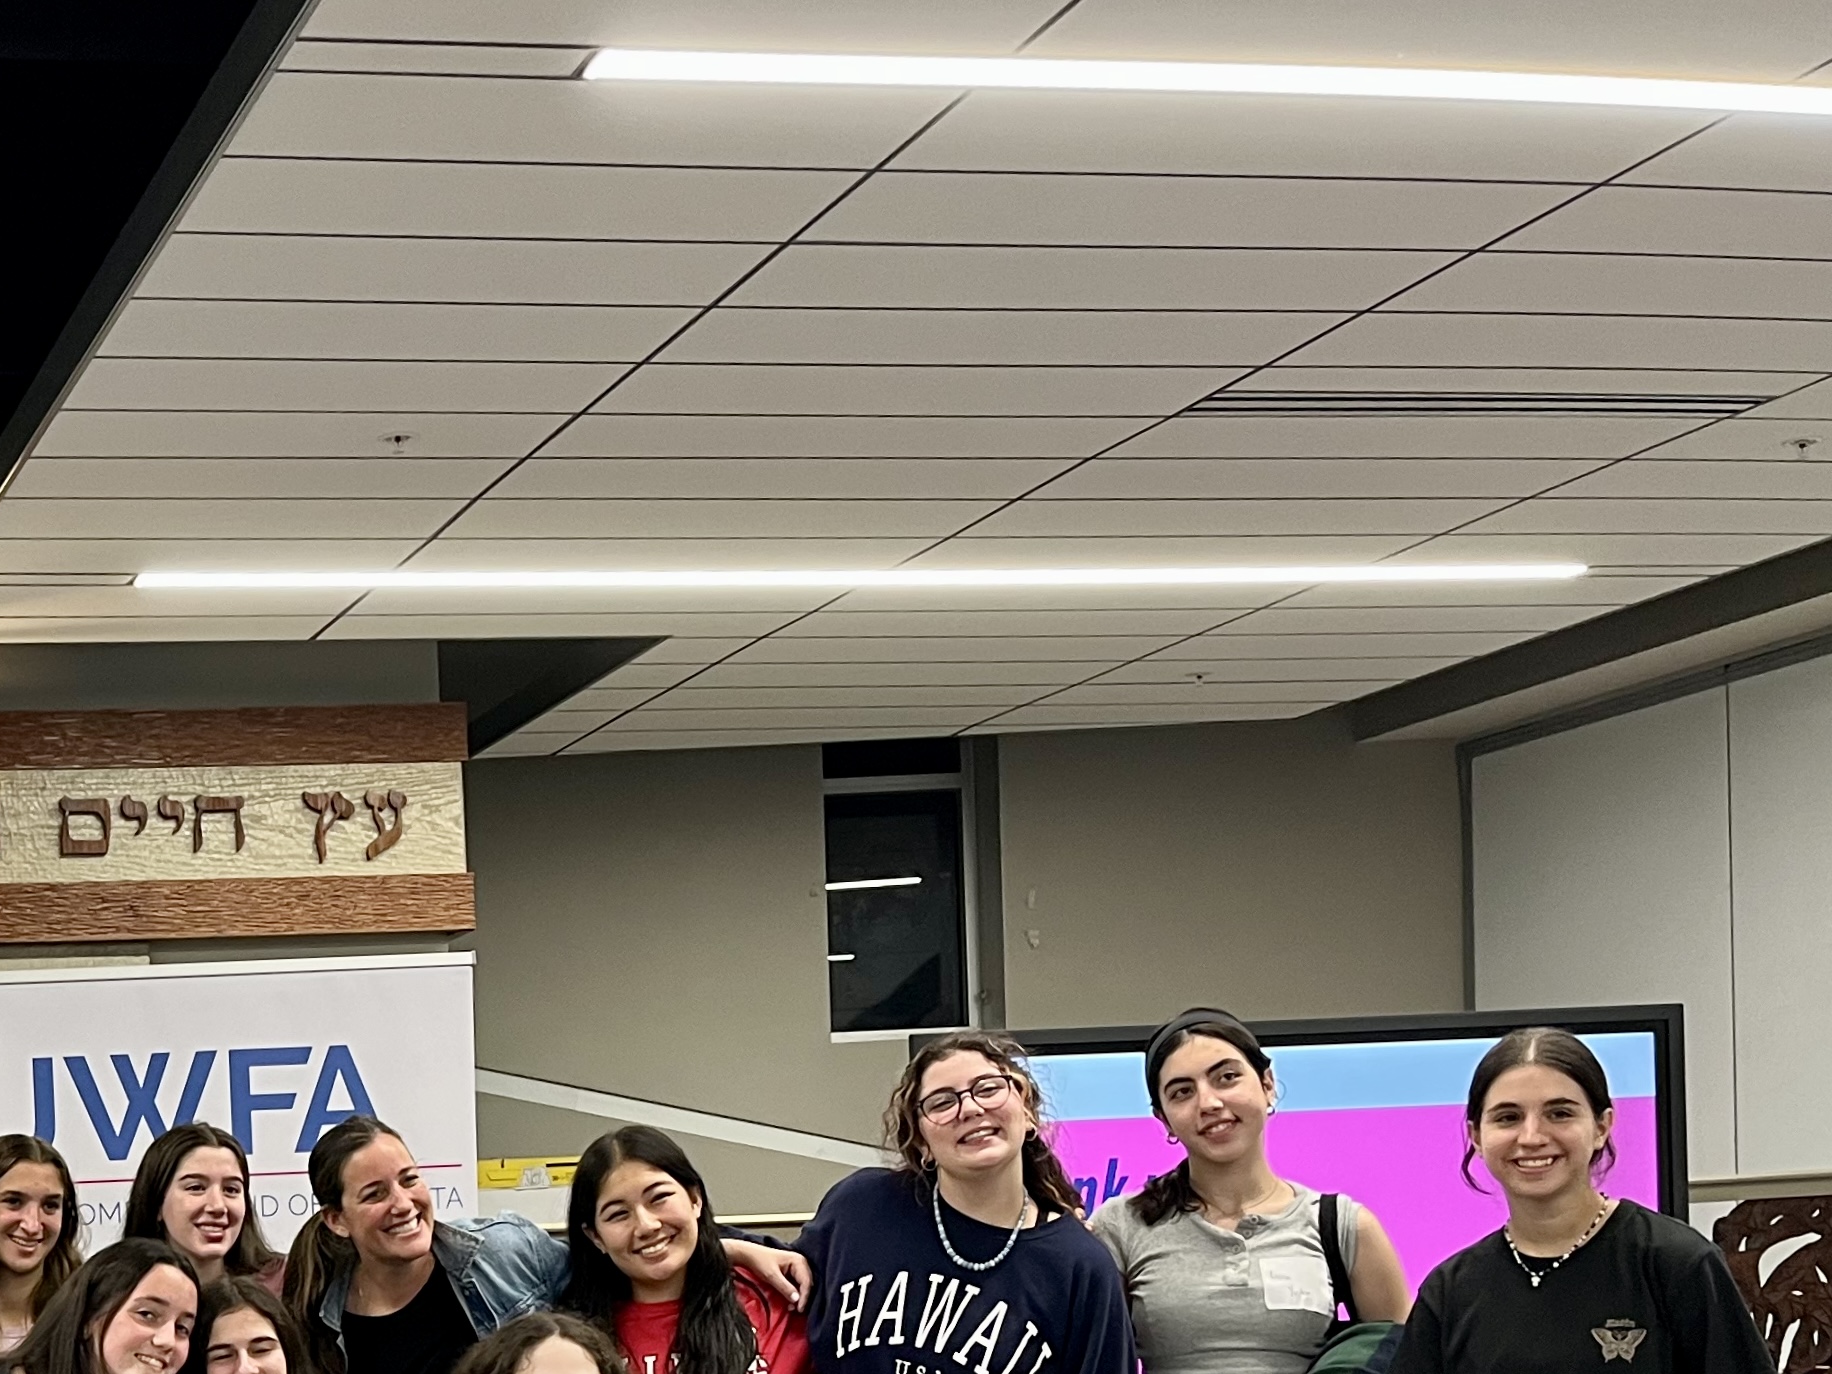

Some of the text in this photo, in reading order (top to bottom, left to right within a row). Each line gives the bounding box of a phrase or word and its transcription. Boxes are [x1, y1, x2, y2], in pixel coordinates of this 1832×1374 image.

[58, 794, 245, 858] חיים
[302, 789, 407, 864] עץ
[32, 1044, 379, 1161] JWFA
